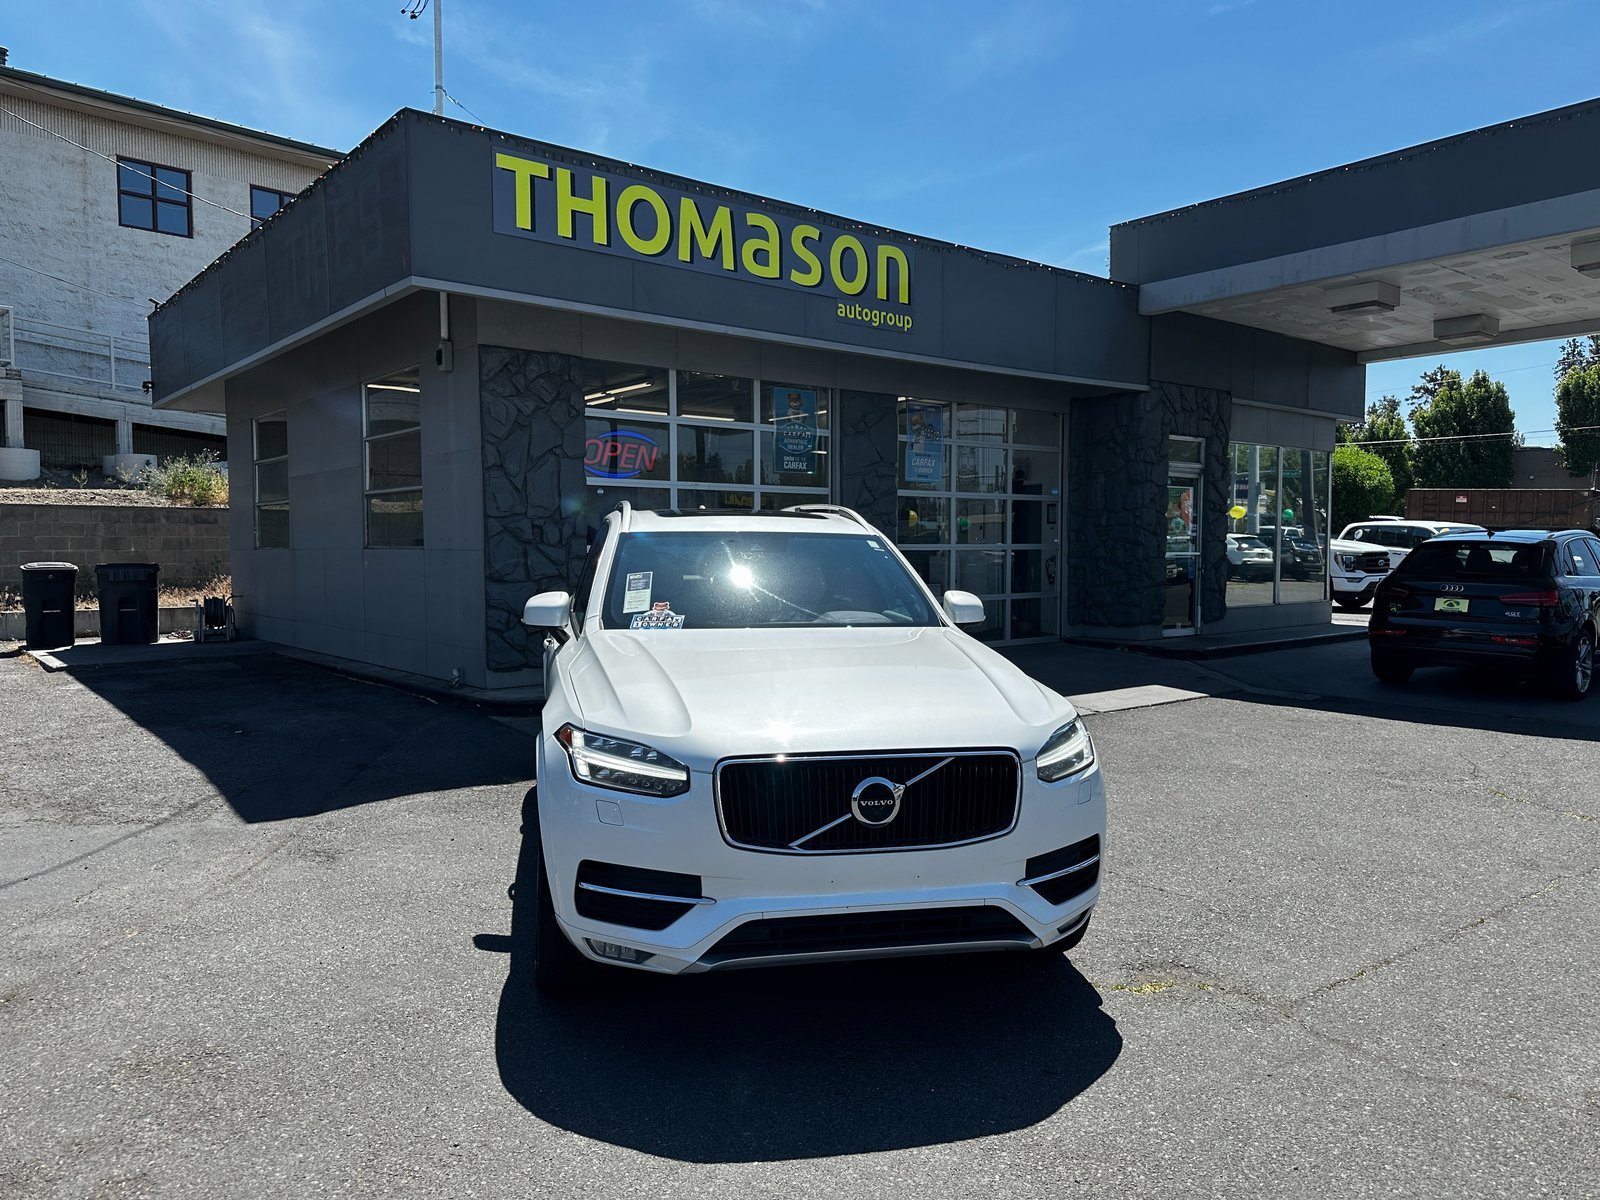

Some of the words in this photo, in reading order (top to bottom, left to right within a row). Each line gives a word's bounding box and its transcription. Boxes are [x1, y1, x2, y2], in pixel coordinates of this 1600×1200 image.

[836, 300, 914, 332] autogroup
[584, 438, 659, 472] OPEN
[783, 461, 807, 470] CARFAX
[911, 457, 936, 468] CARFAX
